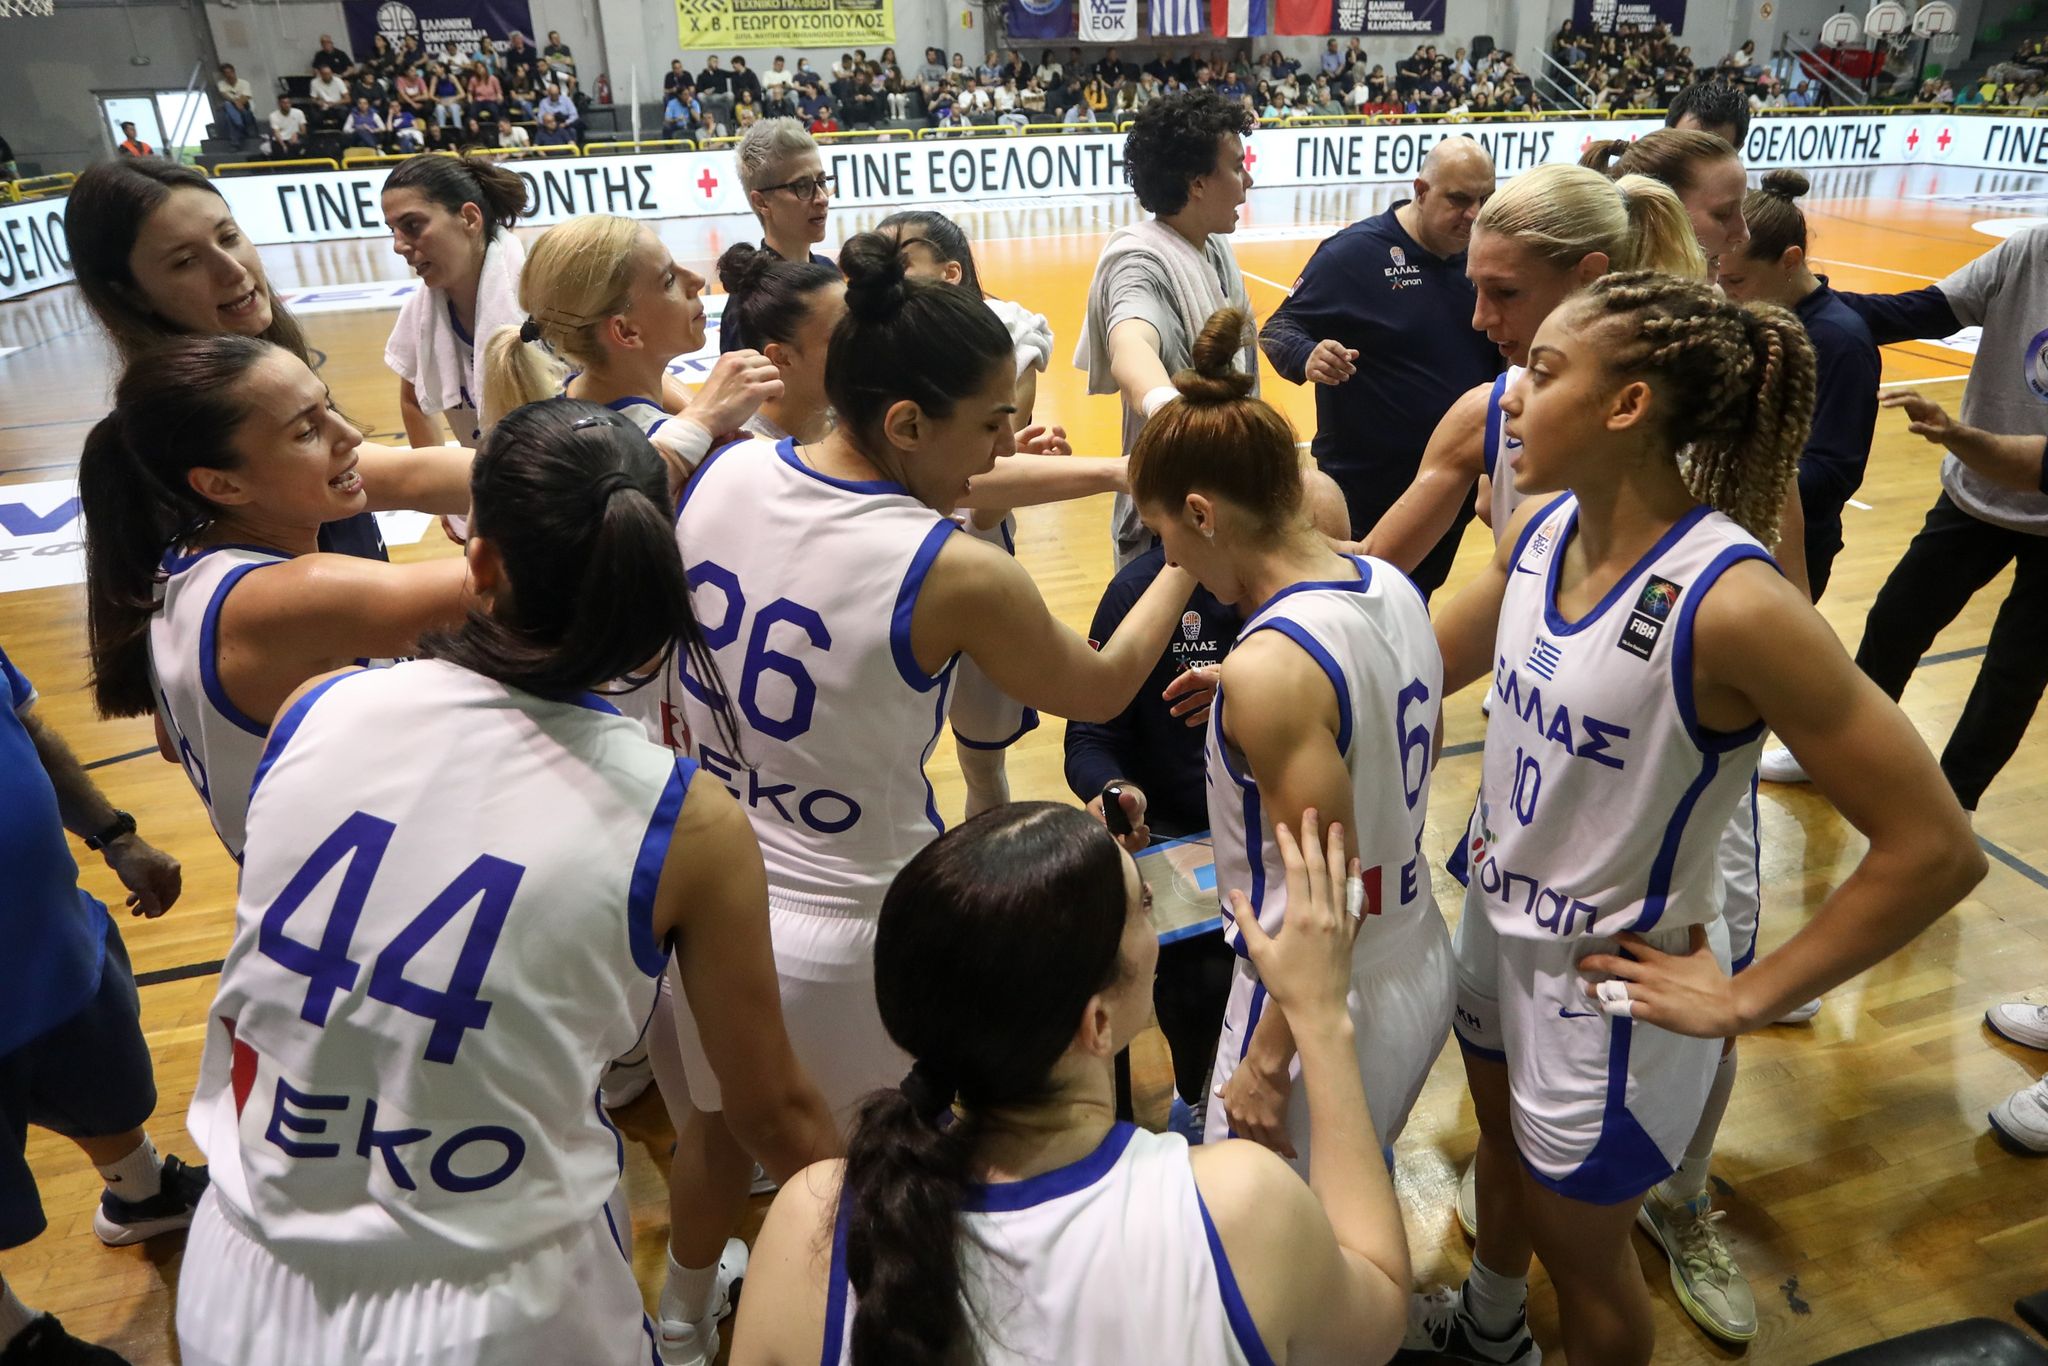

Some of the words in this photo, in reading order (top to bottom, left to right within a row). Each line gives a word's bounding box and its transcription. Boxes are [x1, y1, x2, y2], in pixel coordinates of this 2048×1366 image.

[733, 14, 885, 30] ΓΕΩΡΓΟΥΣΟΠΟΥΛΟΣ
[1297, 135, 1362, 177] ΓΙΝΕ
[1747, 123, 1886, 162] ΘΕΛΟΝΤΗΣ
[1983, 125, 2048, 164] ΓΙΝΕ
[832, 152, 914, 198] ΓΙΝΕ
[928, 145, 1129, 194] ΕΘΕΛΟΝΤΗ
[277, 181, 380, 233] ΓΙΝΕ
[518, 164, 658, 218] ΟΝΤΗΣ
[1384, 265, 1420, 277] ΕΛΛΑΣ
[1172, 640, 1218, 653] ΕΛΛΑΣ
[1630, 618, 1657, 640] FIBA
[1496, 655, 1630, 770] ΕΛΛΑΣ
[1397, 677, 1430, 811] 6
[1510, 746, 1542, 827] 10
[258, 810, 526, 1065] 44
